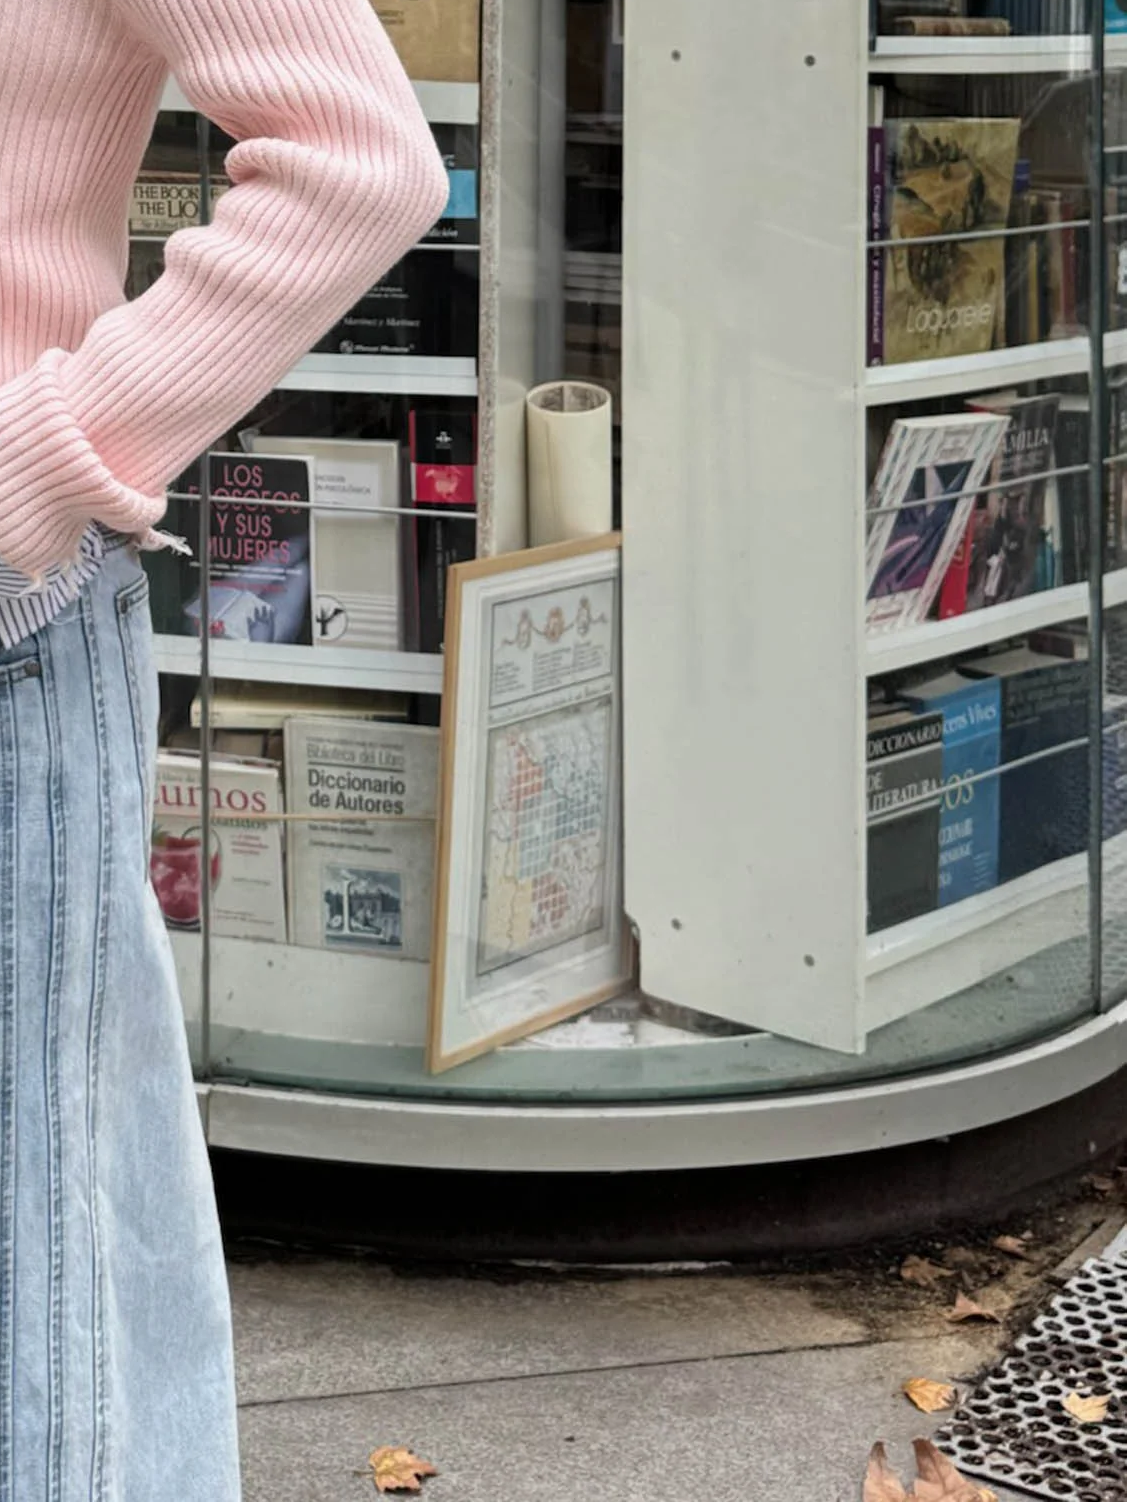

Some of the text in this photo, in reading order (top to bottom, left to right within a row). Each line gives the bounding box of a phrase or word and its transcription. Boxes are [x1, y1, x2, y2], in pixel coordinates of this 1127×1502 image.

[134, 185, 158, 198] THE
[160, 185, 199, 199] BOOK
[136, 201, 166, 215] THE
[224, 464, 263, 487] LOS
[188, 486, 301, 515] FOSOFOS
[216, 513, 272, 538] Y SUS
[867, 721, 942, 759] DICCIONARIO
[308, 768, 406, 796] Diccionario
[154, 785, 267, 813] umos
[309, 789, 404, 815] de Autores
